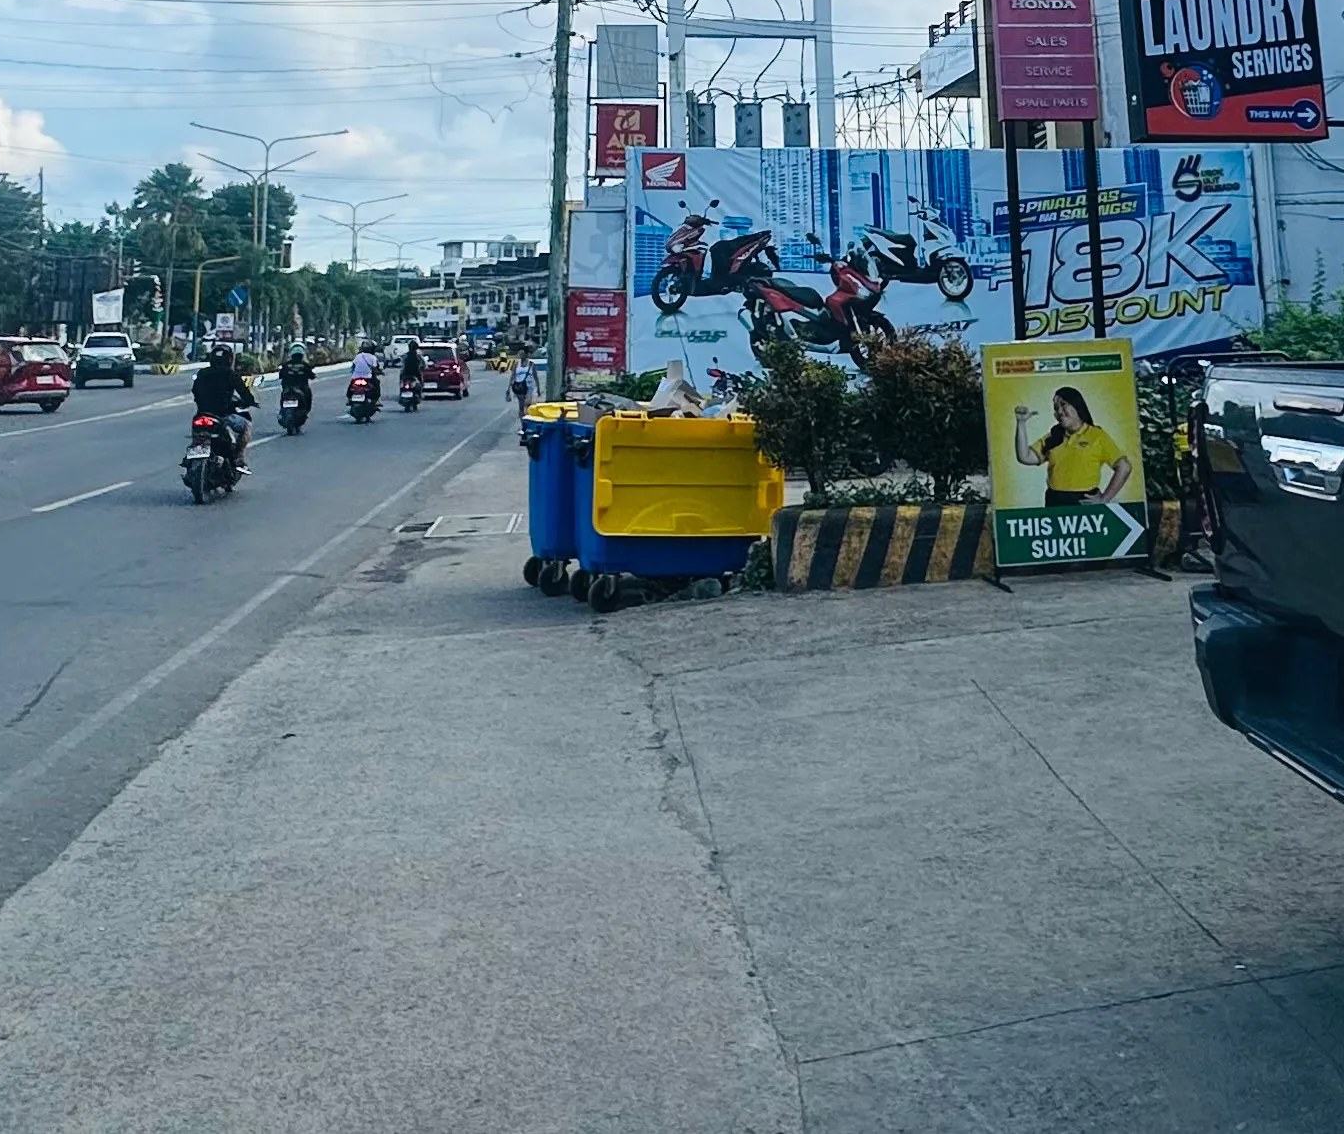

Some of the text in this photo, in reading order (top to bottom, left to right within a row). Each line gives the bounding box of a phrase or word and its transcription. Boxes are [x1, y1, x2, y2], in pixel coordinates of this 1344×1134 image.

[1011, 0, 1077, 11] HONDA
[1025, 35, 1068, 48] SALES
[1231, 42, 1314, 80] SERVICES
[1025, 65, 1073, 77] SERVICE
[1014, 97, 1089, 108] SPARE PARTS
[1249, 109, 1295, 120] THIS WAY
[607, 133, 647, 148] AUB
[1026, 189, 1120, 214] PINALAAS
[1039, 200, 1137, 223] NA SAVNGS!
[1006, 513, 1109, 538] THIS WAY,
[1031, 537, 1087, 559] SUKI!
